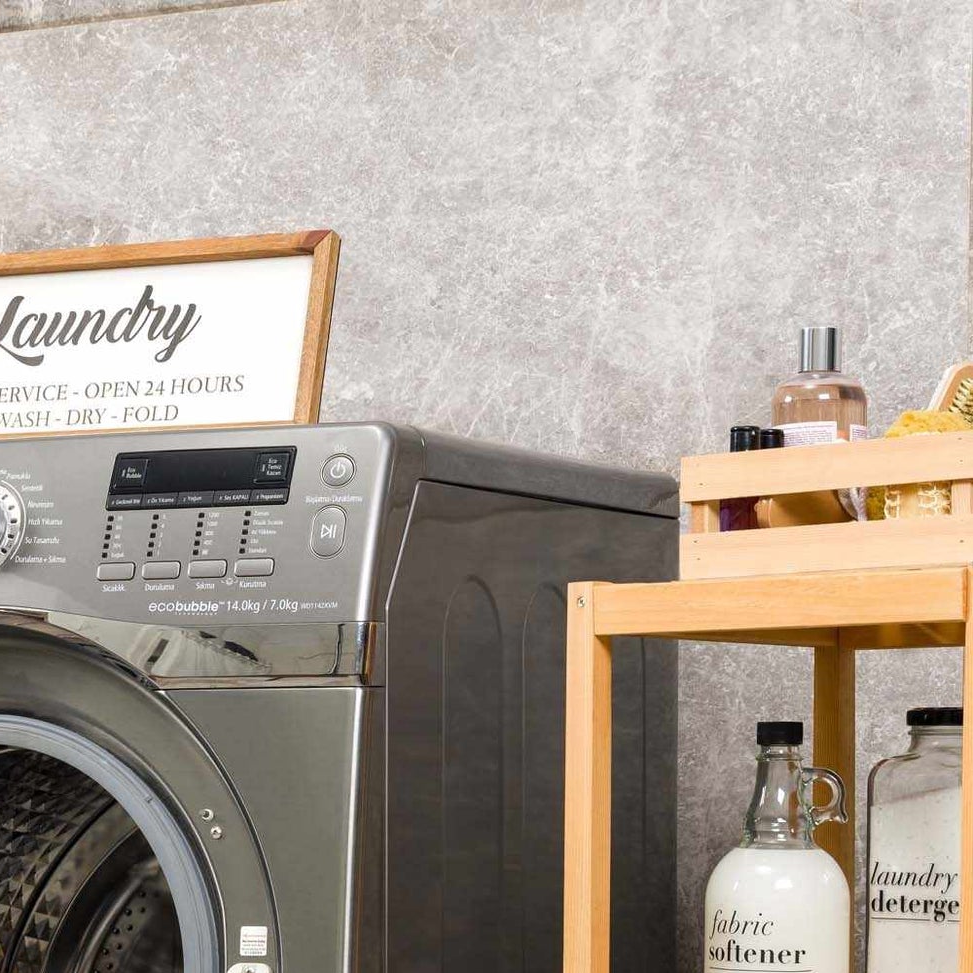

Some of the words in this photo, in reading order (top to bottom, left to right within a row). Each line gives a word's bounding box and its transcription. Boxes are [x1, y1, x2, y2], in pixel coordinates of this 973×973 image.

[84, 380, 141, 399] OPEN
[144, 379, 166, 397] 24
[171, 374, 245, 395] HOURS
[67, 408, 107, 426] DRY
[122, 404, 179, 424] FOLD
[227, 599, 260, 614] 14.0kg
[270, 598, 299, 613] 7.0kg
[870, 861, 959, 895] laundry
[871, 889, 960, 923] deterge
[708, 908, 774, 940] fabric
[708, 938, 806, 965] softener
